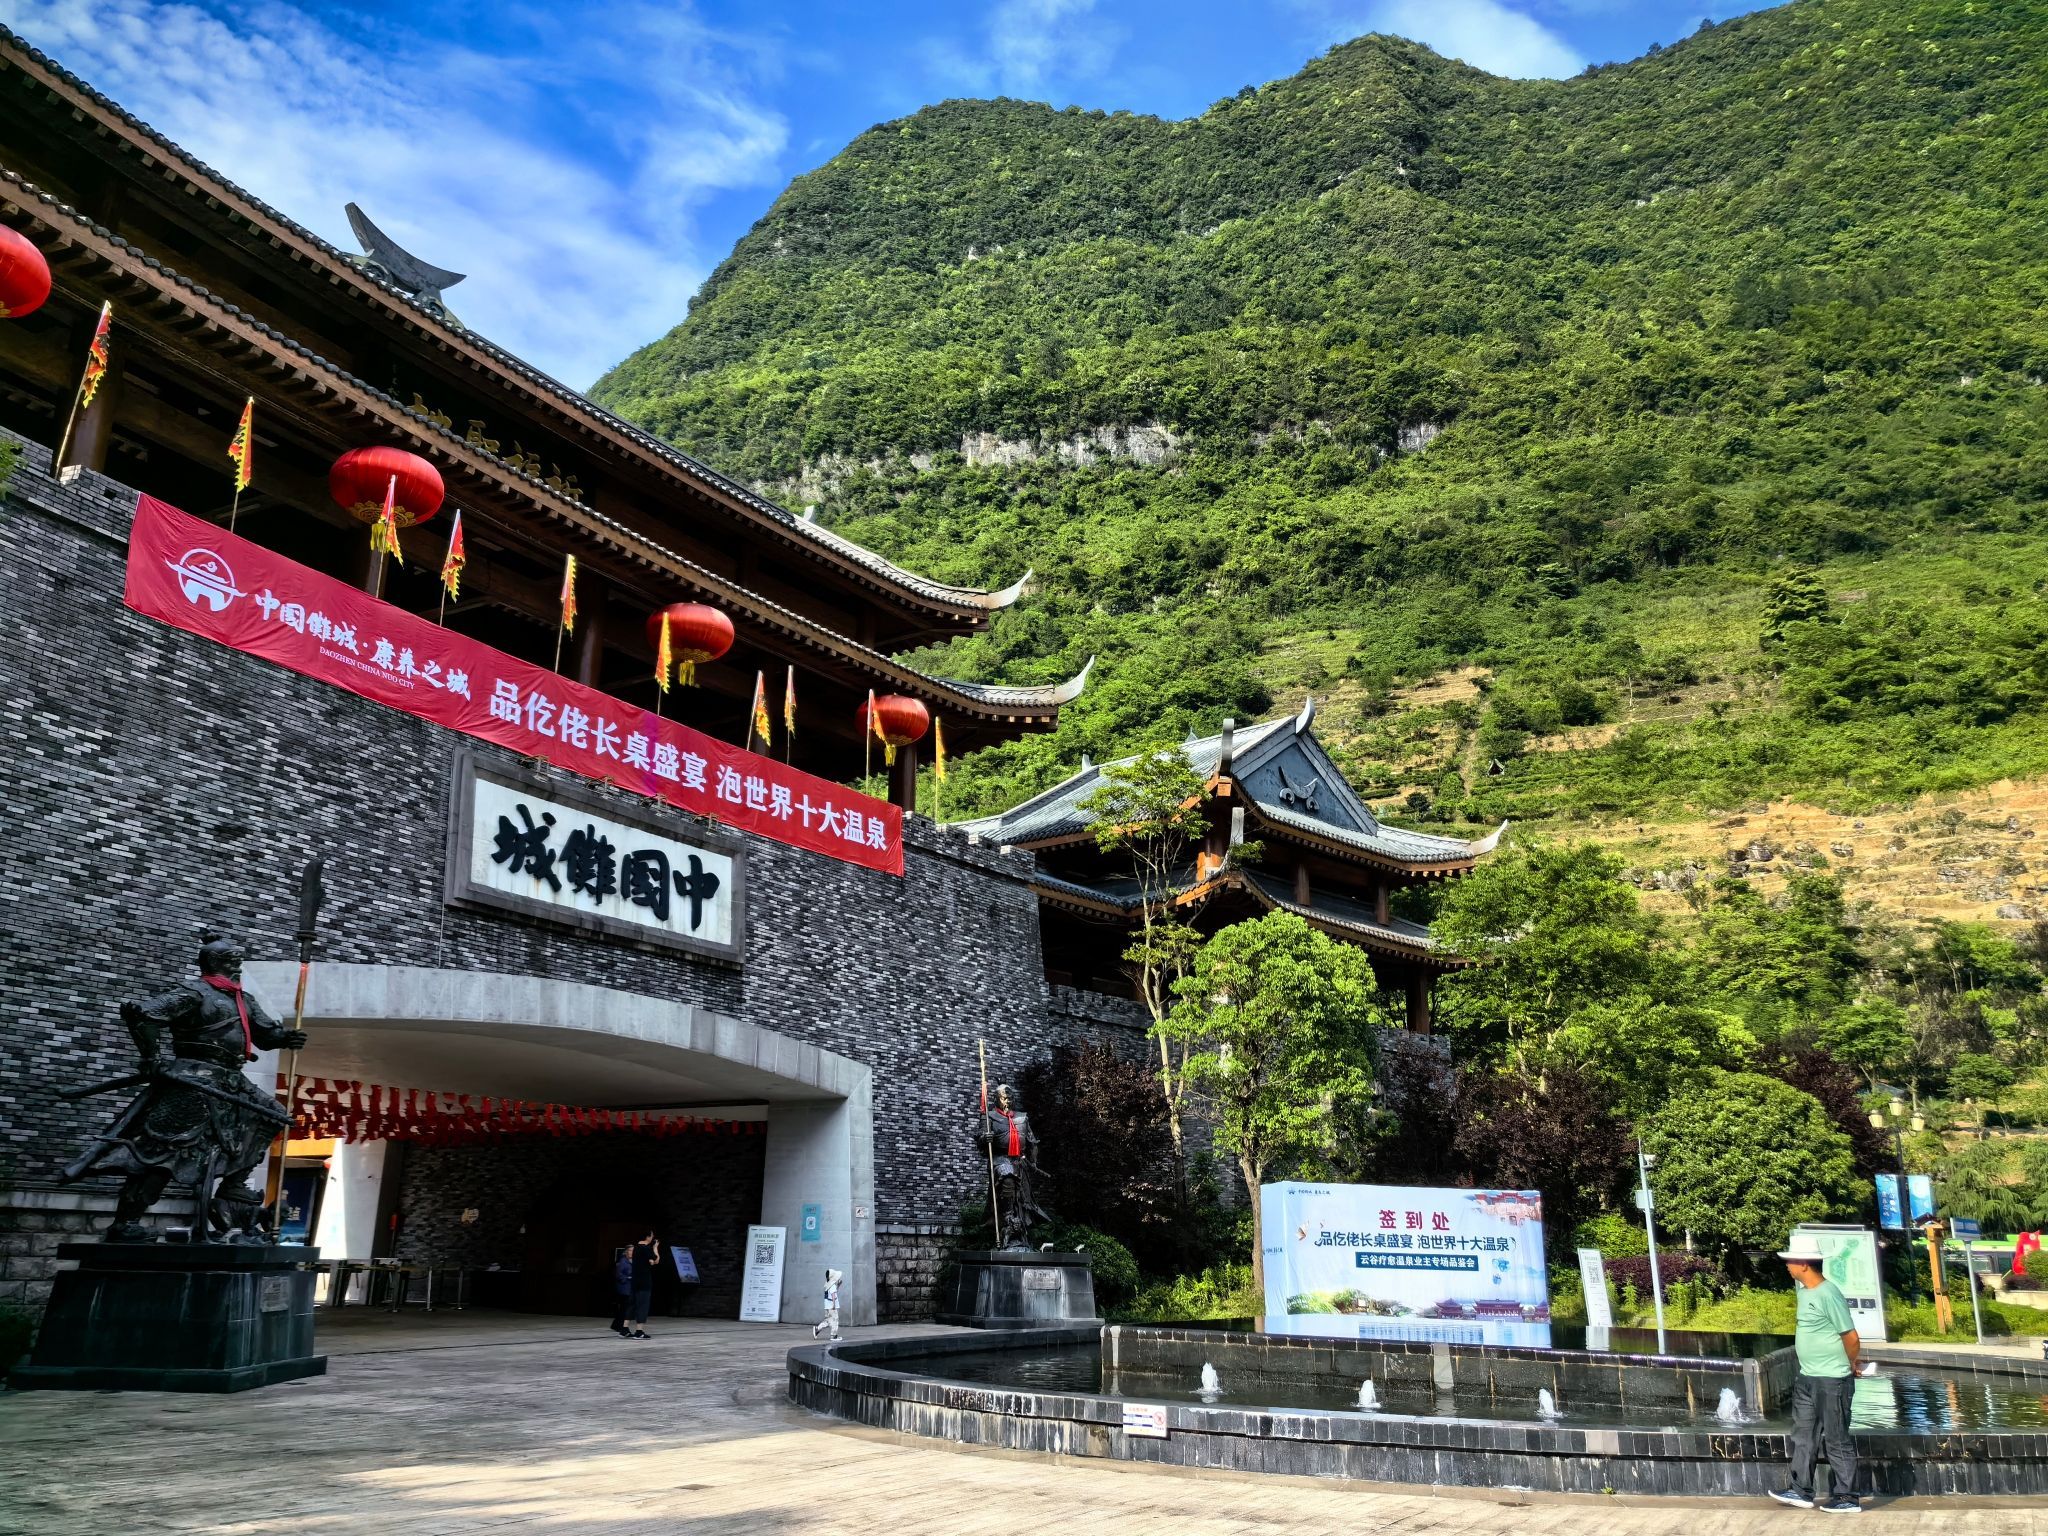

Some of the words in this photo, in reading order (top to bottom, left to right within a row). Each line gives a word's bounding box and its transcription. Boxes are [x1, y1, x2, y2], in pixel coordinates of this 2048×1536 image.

[319, 645, 356, 667] DAOZHEN
[357, 661, 381, 677] CHINA
[398, 677, 415, 690] CITY
[489, 677, 708, 793] 品仡佬长桌盛宴
[716, 763, 888, 851] 泡世界十大温泉
[1378, 1209, 1450, 1231] 签到处
[1319, 1231, 1413, 1249] 品仡佬长桌盛宴
[1417, 1234, 1510, 1251] 泡世界十大温泉
[1360, 1254, 1475, 1268] 云谷疗愈温泉业主专场品鉴会
